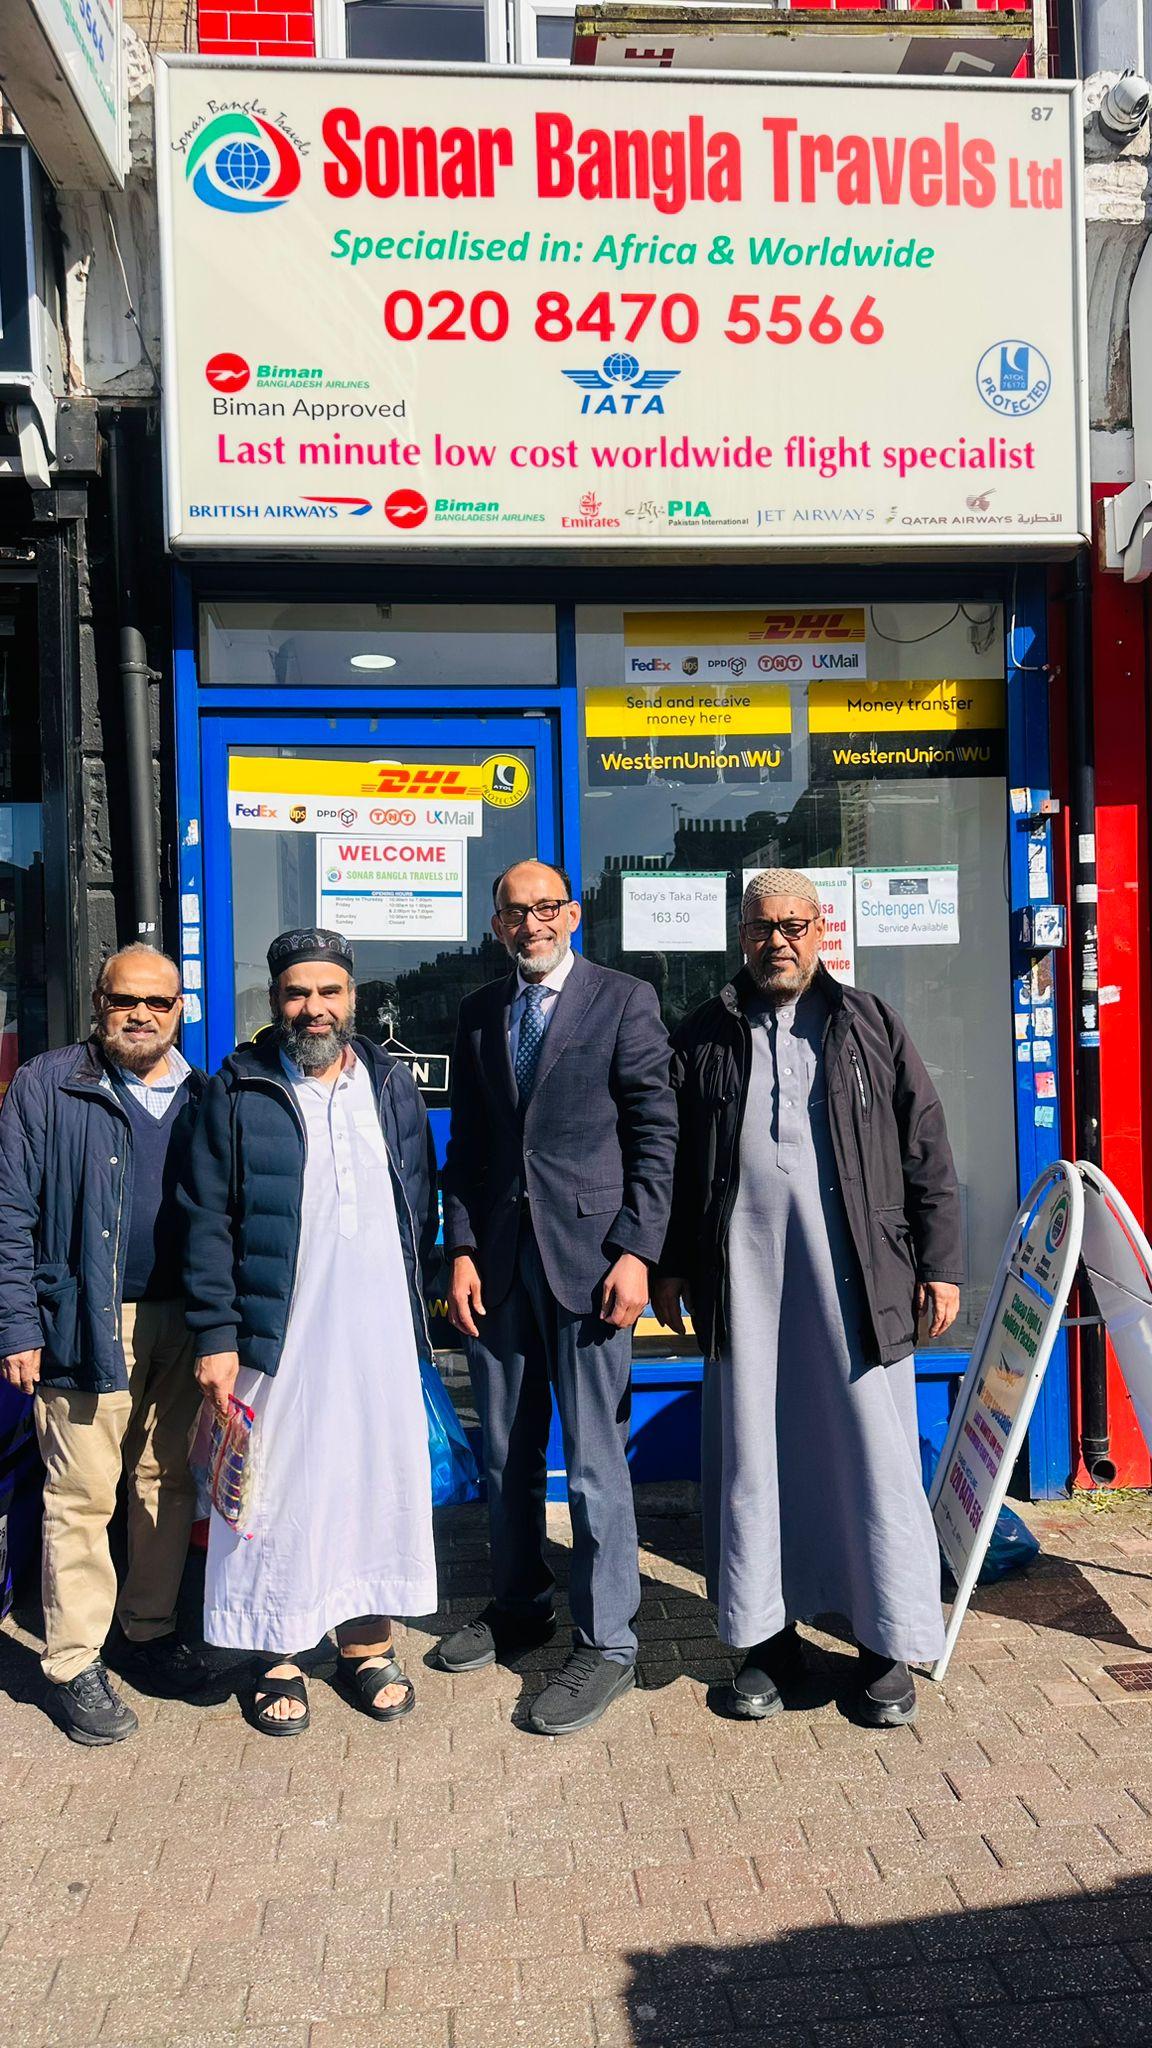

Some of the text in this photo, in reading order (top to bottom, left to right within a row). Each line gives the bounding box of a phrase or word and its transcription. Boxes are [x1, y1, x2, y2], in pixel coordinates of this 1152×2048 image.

[1031, 107, 1053, 121] 87
[322, 107, 1063, 214] Sonar Bangla Travels Ltd
[330, 229, 936, 270] Specialised in: Africa & Worldwide
[383, 290, 885, 346] 020 8470 5566
[256, 365, 323, 378] Biman
[256, 380, 370, 389] BANGLADESH AIRLINES
[981, 377, 1048, 413] PROTECTED
[212, 397, 406, 421] Biman Approved
[580, 394, 666, 415] IATA
[217, 433, 1036, 478] Last minute low cost worldwide flight specialist
[189, 505, 338, 518] BRITISH AIRWAYS
[434, 498, 499, 512] Biman
[668, 500, 711, 517] PIA
[434, 513, 545, 522] BANGLADESH AIRLINES
[561, 516, 621, 528] Emirates
[668, 518, 749, 527] Pakistan International
[756, 508, 876, 527] JET AIRWAYS
[901, 515, 1013, 526] QATAR AIRWAYS
[764, 614, 853, 639] DHL
[631, 658, 671, 672] FedEx
[708, 660, 727, 668] DPD
[760, 657, 800, 670] TNT
[626, 695, 751, 709] Send and receive
[847, 696, 973, 714] Money transfer
[646, 711, 732, 727] money here
[600, 753, 740, 770] WesternUnion
[832, 750, 955, 765] WesternUnion
[377, 769, 467, 793] DHL
[236, 803, 277, 818] FedEx
[289, 808, 306, 823] ups
[316, 809, 337, 819] DPD
[371, 810, 414, 823] TNT
[338, 845, 446, 862] WELCOME
[346, 870, 459, 881] SONAR BANGLA TRAVELS LTD
[628, 891, 718, 904] Today's Taka Rate
[861, 899, 955, 919] Schengen Visa
[651, 912, 690, 923] 163.50
[878, 922, 948, 933] Service Available
